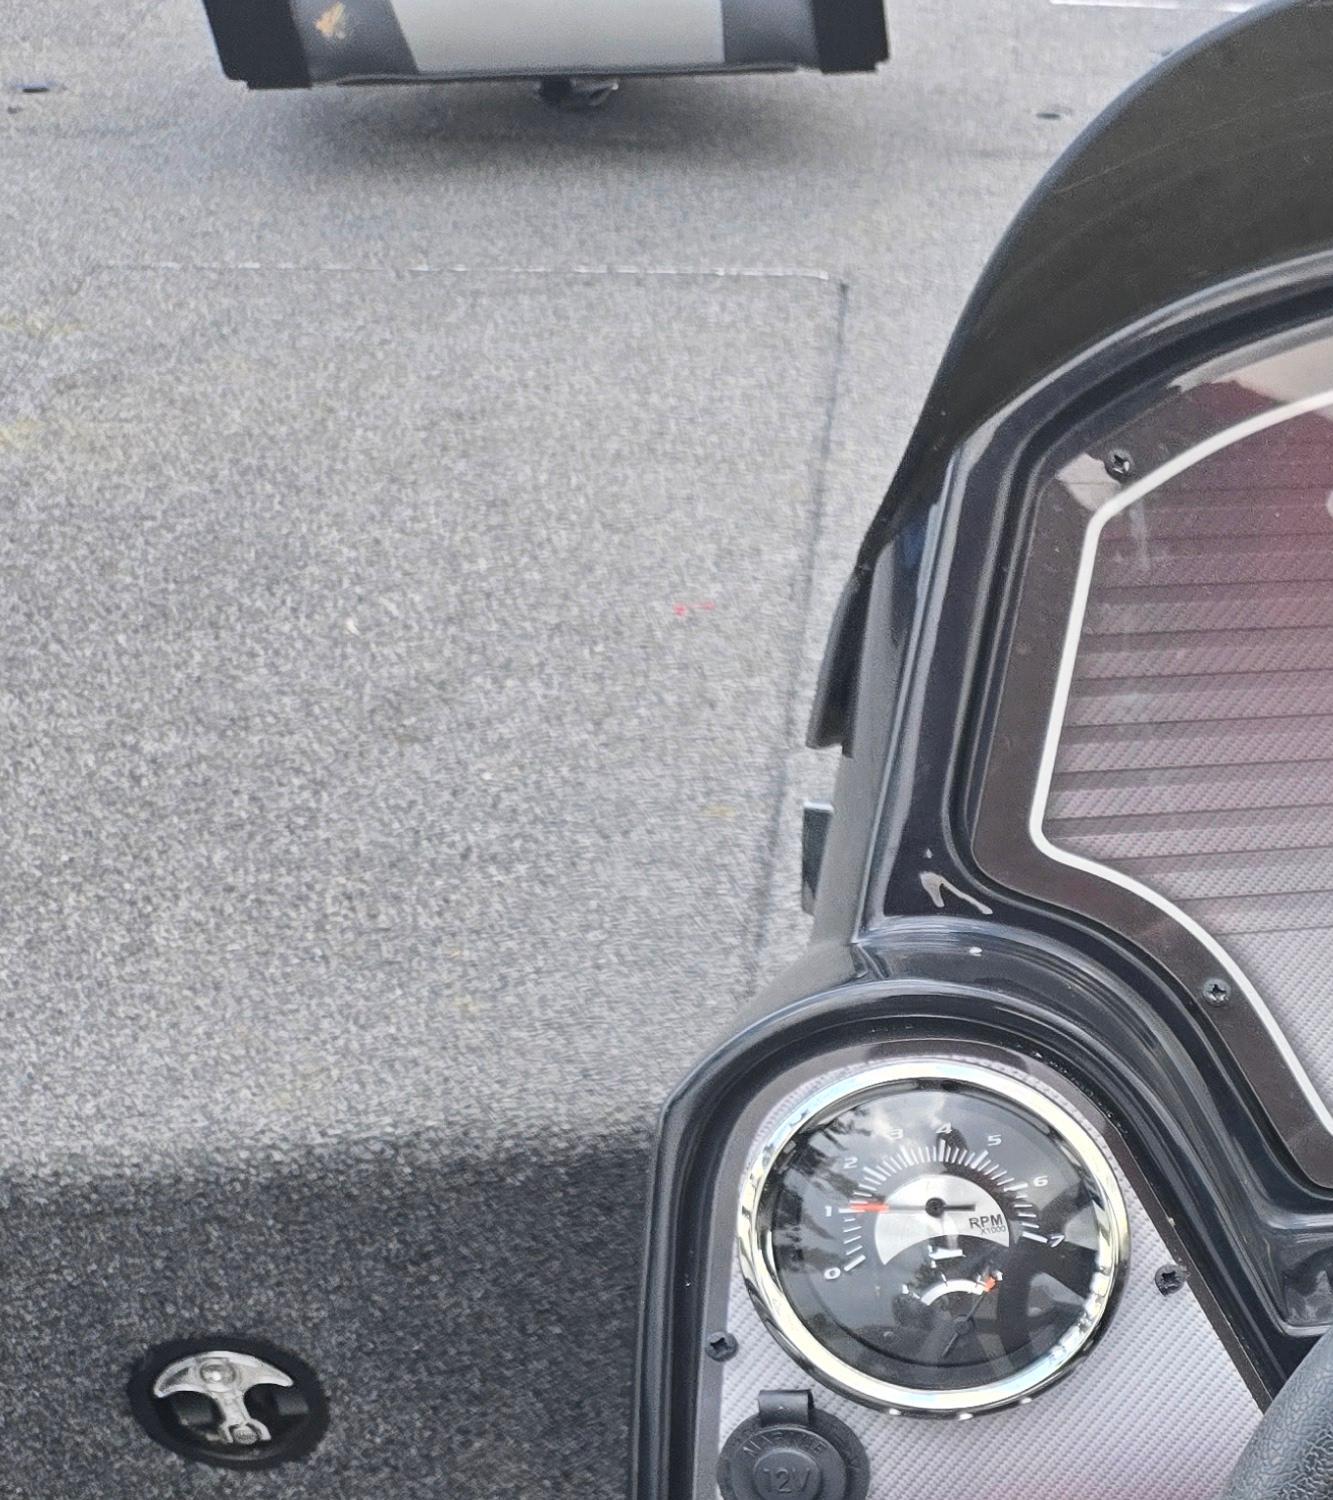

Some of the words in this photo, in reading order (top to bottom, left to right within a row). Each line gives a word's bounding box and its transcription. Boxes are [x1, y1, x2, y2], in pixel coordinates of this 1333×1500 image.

[890, 1128, 904, 1140] 3
[936, 1124, 953, 1134] 4
[988, 1134, 1002, 1146] 5
[844, 1156, 858, 1169] 2
[1033, 1176, 1048, 1188] 6
[824, 1206, 832, 1217] 1
[968, 1214, 1003, 1230] RPM
[1050, 1235, 1065, 1248] 7
[823, 1267, 841, 1281] 0
[762, 1467, 811, 1494] 12V
